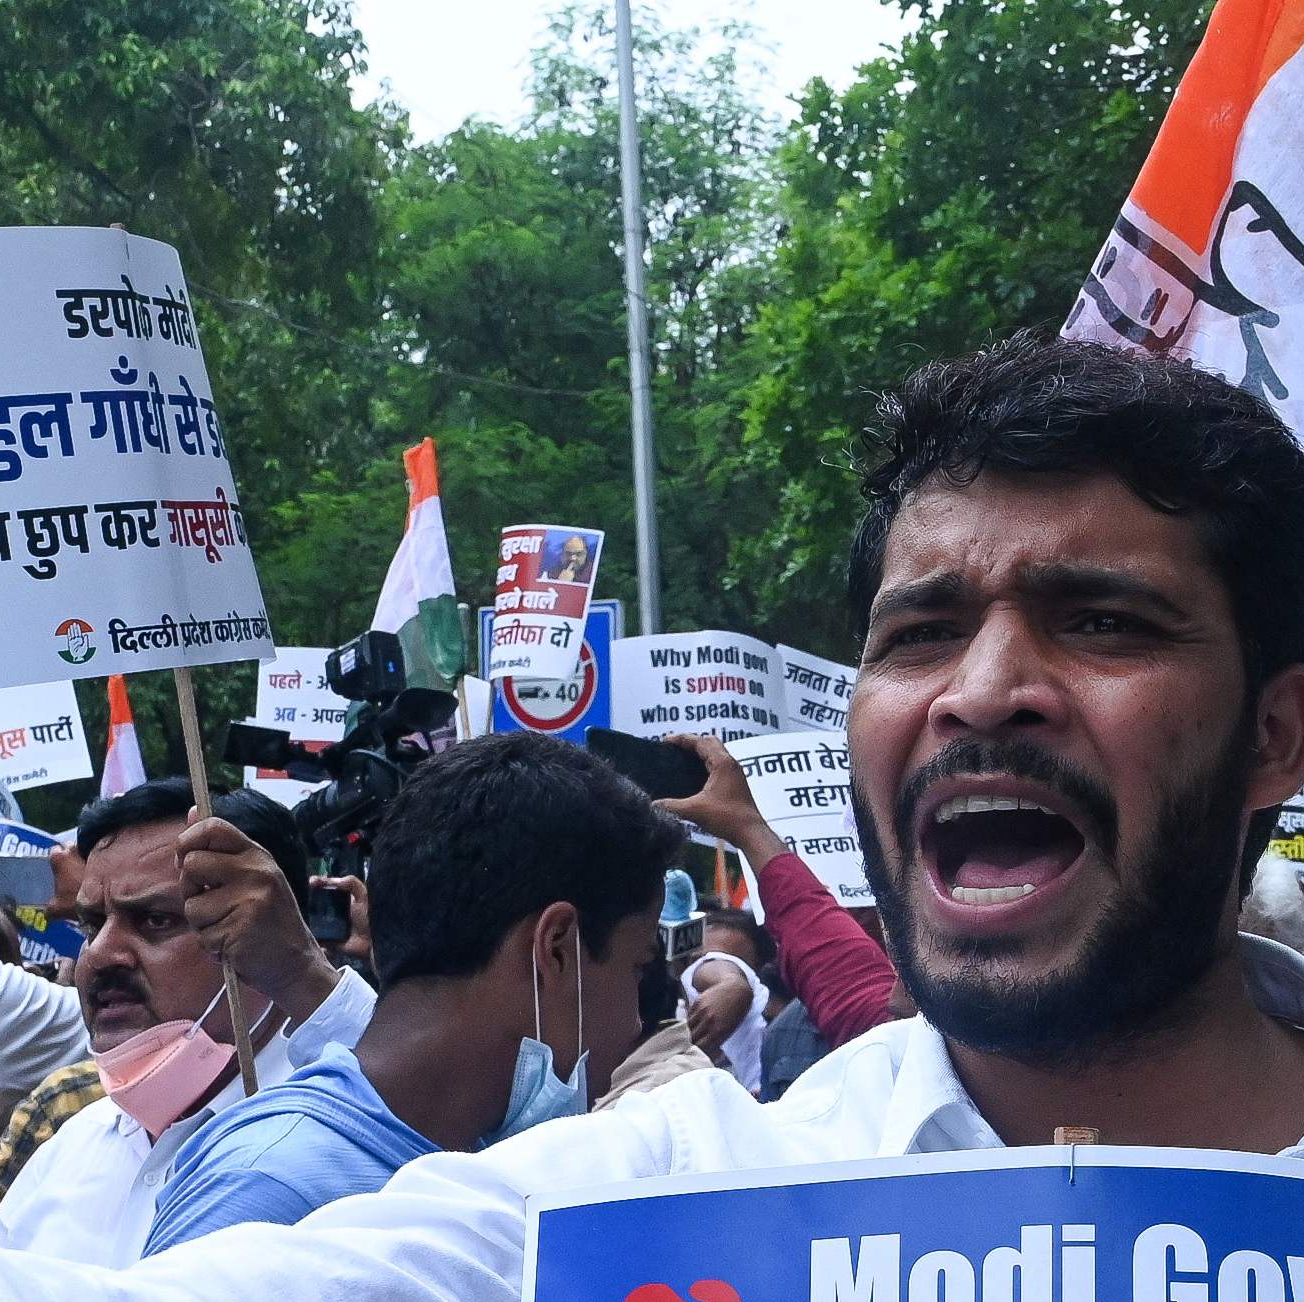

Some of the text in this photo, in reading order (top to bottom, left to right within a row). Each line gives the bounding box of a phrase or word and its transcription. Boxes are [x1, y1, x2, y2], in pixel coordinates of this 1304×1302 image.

[56, 274, 152, 340] डरपोक
[80, 355, 171, 455] गाँधी
[168, 375, 205, 456] से
[17, 505, 90, 580] छुप
[94, 500, 161, 550] कर
[161, 487, 236, 563] जासूसी
[108, 614, 179, 653] दिल्ली
[180, 614, 213, 646] प्रदेश
[214, 610, 252, 643] कांग्रेस
[550, 622, 574, 649] दो
[650, 648, 692, 668] Why
[697, 645, 740, 665] Modi
[269, 670, 302, 689] पहले
[555, 682, 580, 702] 40
[664, 673, 765, 698] is spying on
[785, 662, 832, 695] जनता
[274, 707, 296, 723] अब
[312, 708, 346, 725] अपन
[641, 704, 680, 724] who
[685, 700, 750, 723] speaks
[752, 707, 768, 727] up
[30, 715, 75, 745] पार्टी
[737, 750, 813, 778] जनता
[801, 836, 857, 856] सरका
